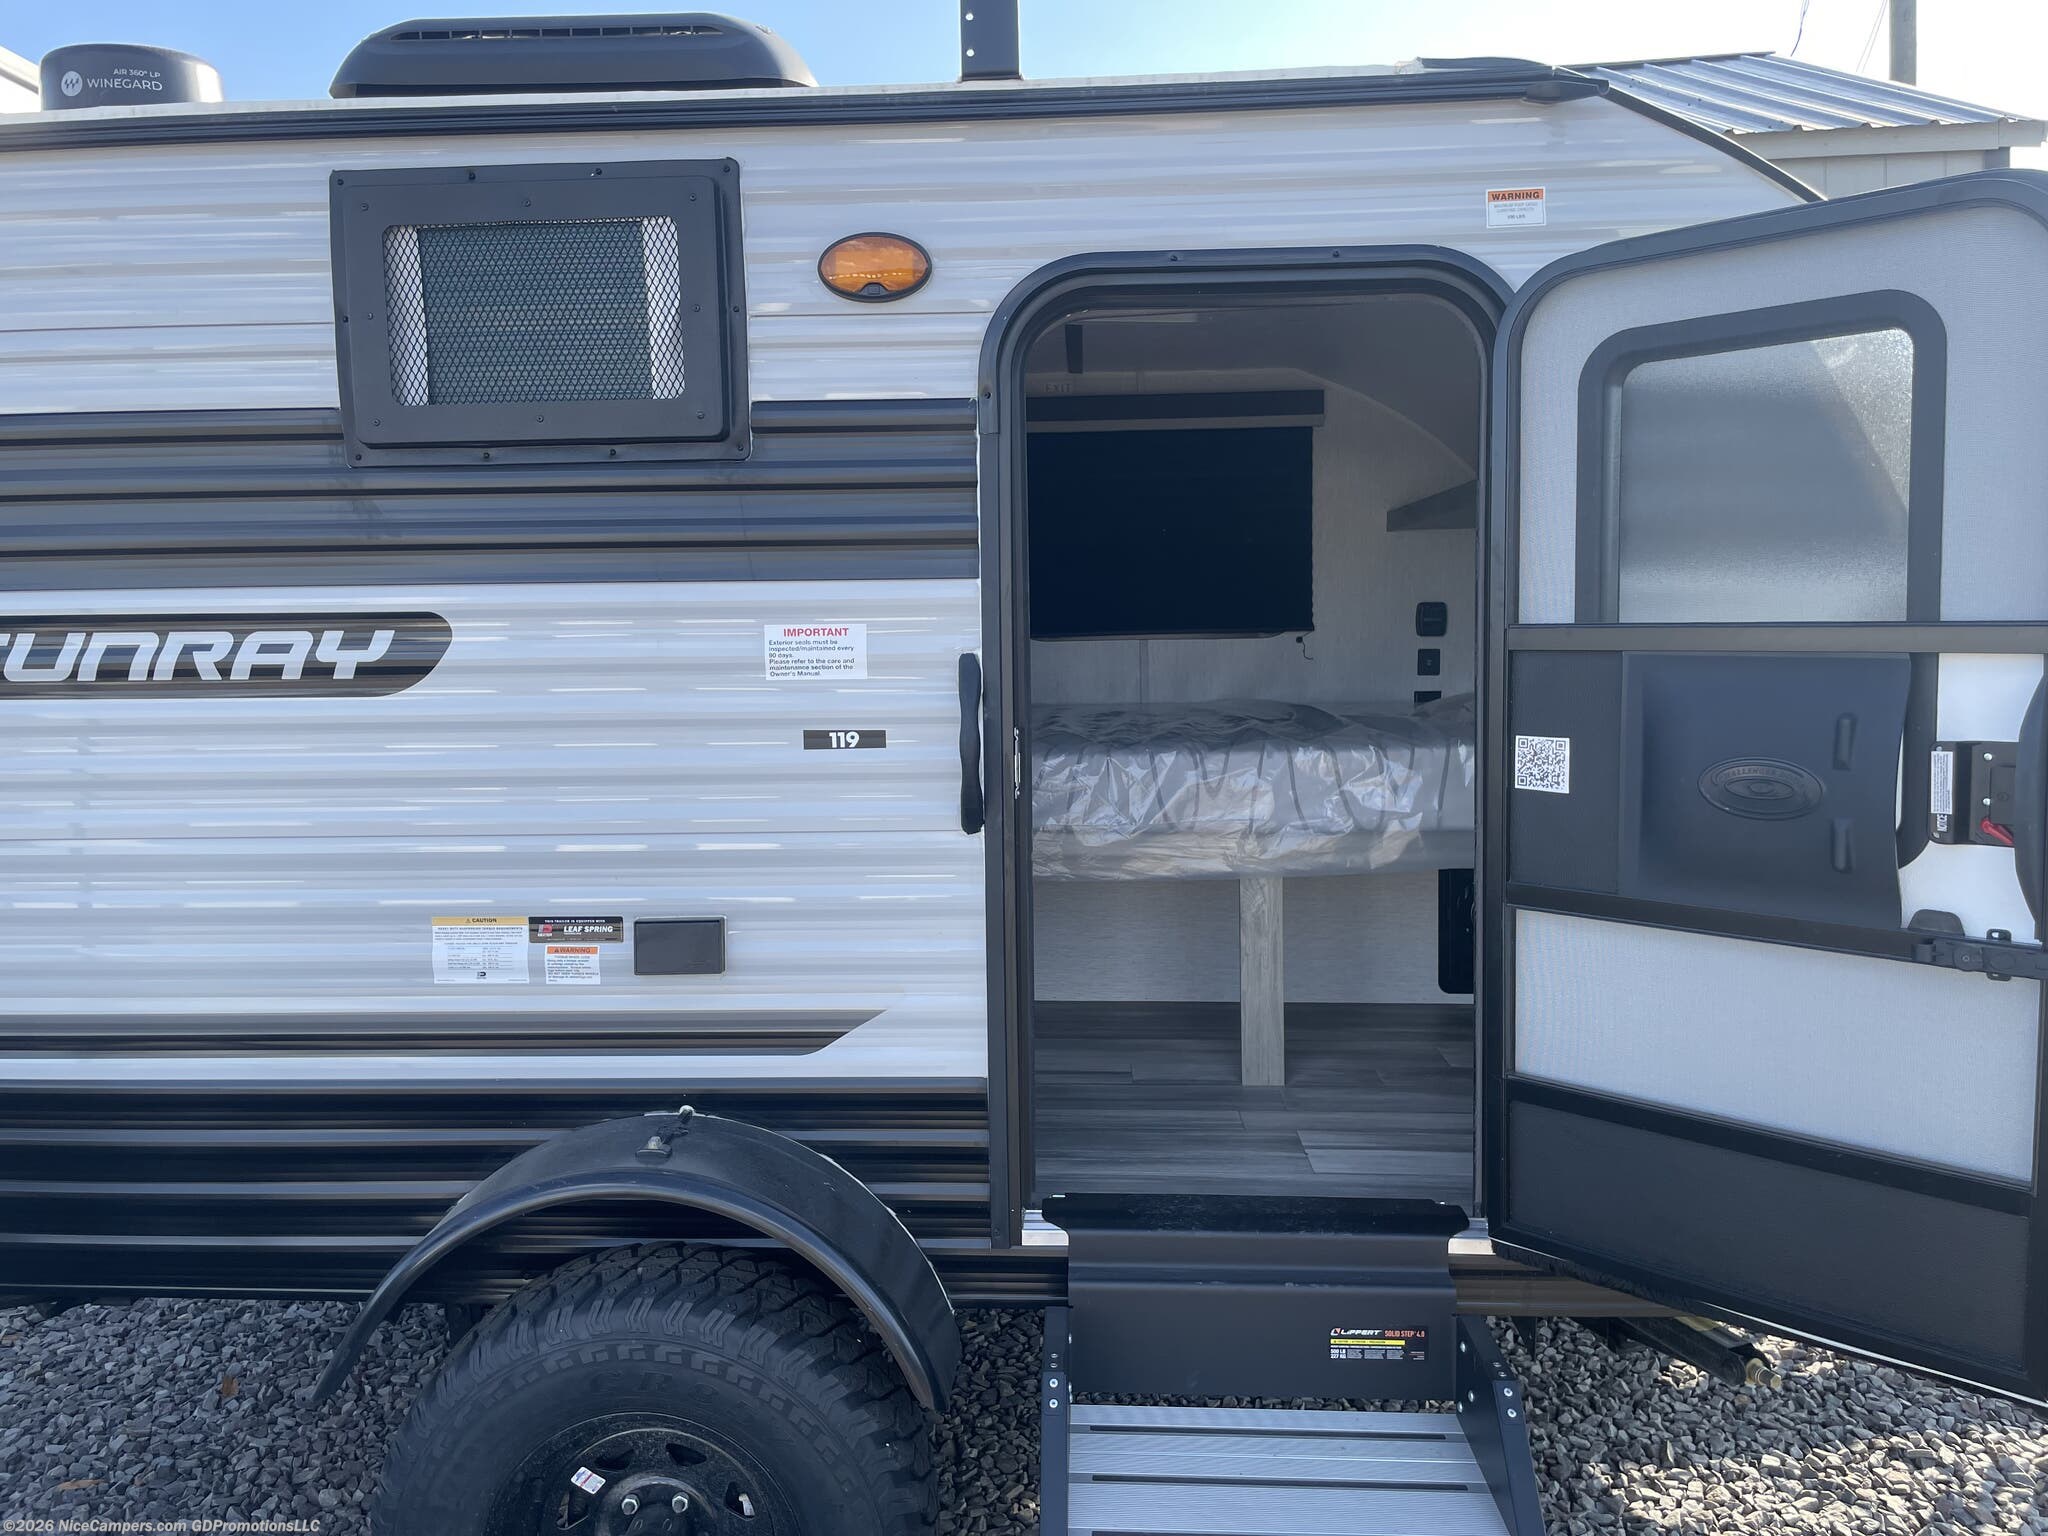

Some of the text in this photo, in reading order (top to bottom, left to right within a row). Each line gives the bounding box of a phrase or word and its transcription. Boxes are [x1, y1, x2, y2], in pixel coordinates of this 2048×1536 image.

[86, 78, 163, 91] WINEGARD
[1491, 191, 1540, 201] WARNING
[783, 627, 849, 637] IMPORTANT
[0, 630, 395, 682] UNRAY
[829, 731, 860, 748] 119
[563, 925, 613, 933] LEAF SPRING
[1384, 1330, 1401, 1338] SOLID
